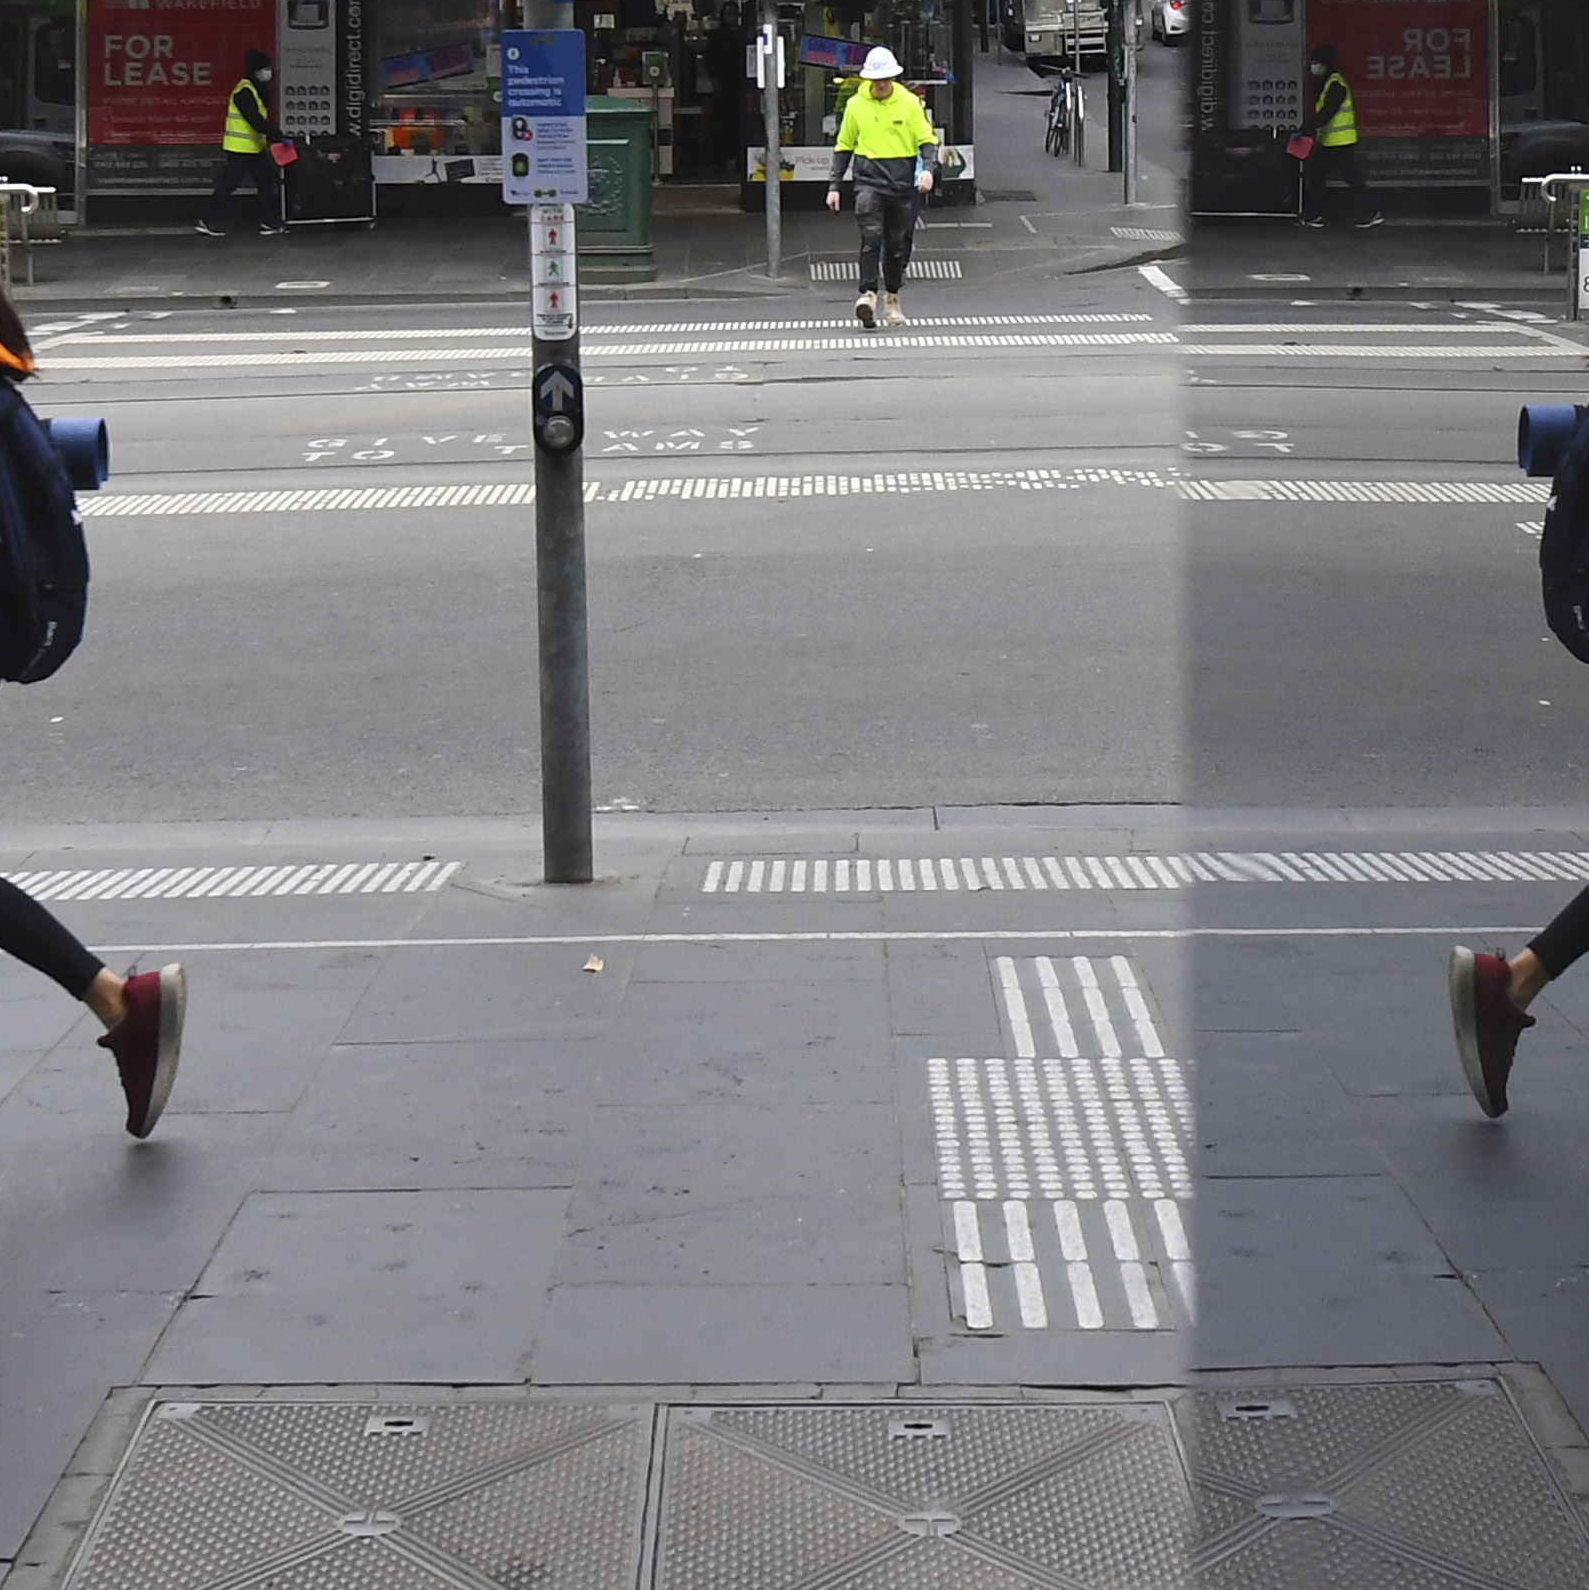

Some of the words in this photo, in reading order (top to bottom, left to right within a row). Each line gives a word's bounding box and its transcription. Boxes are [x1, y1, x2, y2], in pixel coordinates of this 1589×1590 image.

[103, 34, 174, 59] FOR
[103, 61, 212, 87] LEASE
[507, 64, 530, 75] This
[507, 75, 564, 87] pedestrian
[507, 86, 552, 98] crossing
[552, 86, 562, 96] is
[507, 98, 563, 108] automatic
[795, 155, 816, 166] Pick
[817, 157, 830, 168] up
[602, 427, 760, 439] WAY
[303, 450, 395, 462] TO
